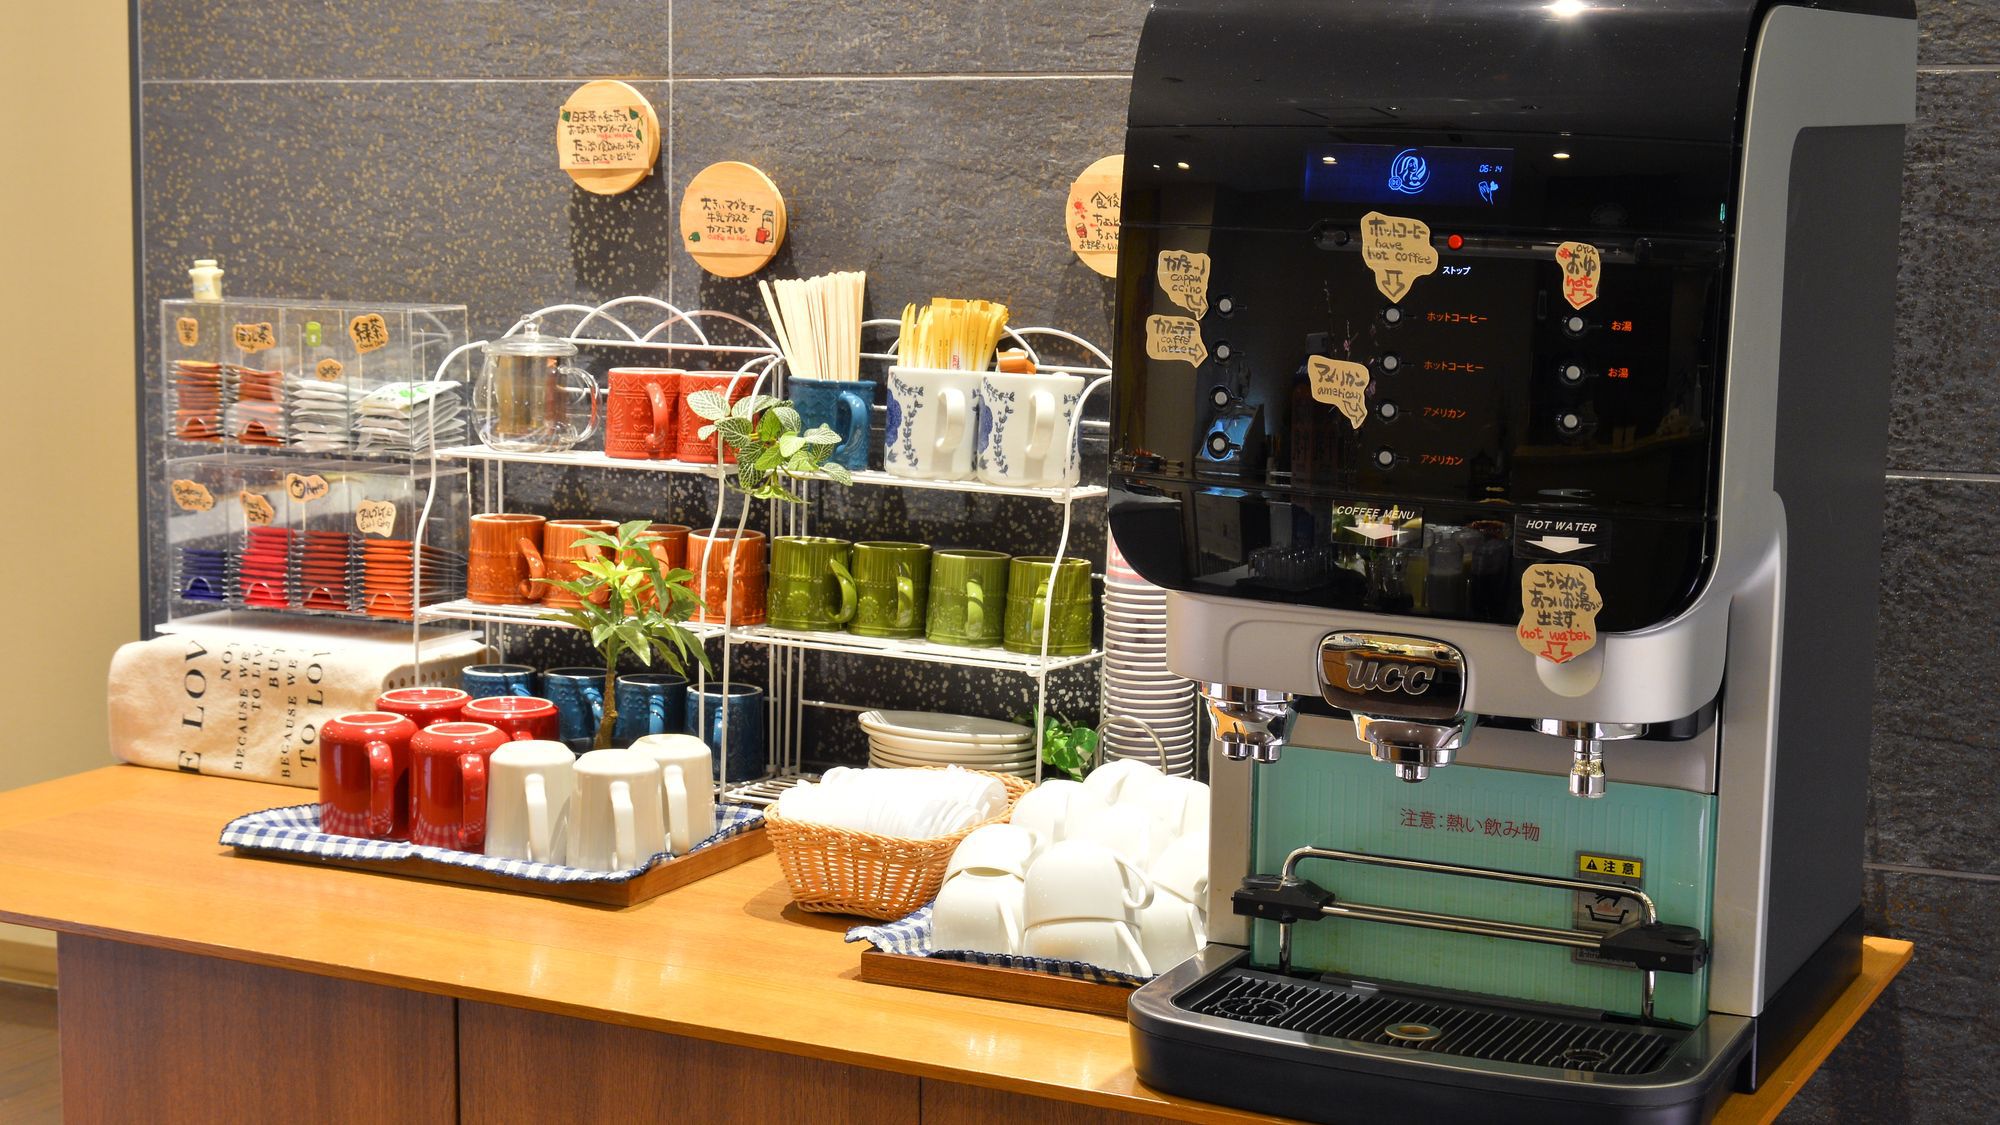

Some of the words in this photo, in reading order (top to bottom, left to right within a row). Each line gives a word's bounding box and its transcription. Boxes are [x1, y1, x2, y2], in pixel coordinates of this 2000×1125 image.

[1369, 216, 1427, 239] ホットコーヒー
[1375, 238, 1404, 250] have
[1367, 245, 1389, 260] hot
[1395, 252, 1432, 264] coffee
[1442, 266, 1471, 276] ストップ
[1567, 275, 1592, 288] hot
[1426, 312, 1488, 324] ホットコーヒー
[353, 318, 383, 342] 緑茶
[1611, 320, 1633, 332] お湯
[1157, 341, 1187, 353] latte
[1423, 361, 1485, 372] ホットコーヒー
[1608, 367, 1629, 378] お湯
[1313, 363, 1366, 387] アメリカン
[1423, 407, 1467, 419] アメリカン
[1420, 454, 1464, 466] アメリカン
[1336, 506, 1380, 518] COFFEE
[1383, 509, 1415, 520] MENU
[1526, 520, 1552, 530] HOT
[1555, 521, 1597, 532] WATER
[1534, 569, 1587, 591] こちらから
[1520, 625, 1544, 639] hot
[1549, 628, 1592, 641] water
[239, 651, 251, 678] WE
[252, 646, 264, 679] LIV
[287, 659, 299, 686] WE
[251, 688, 262, 711] TO
[234, 688, 249, 770] BECAUSE
[280, 696, 297, 778] BECAUSE
[299, 724, 318, 768] TO
[1603, 860, 1635, 875] 注意
